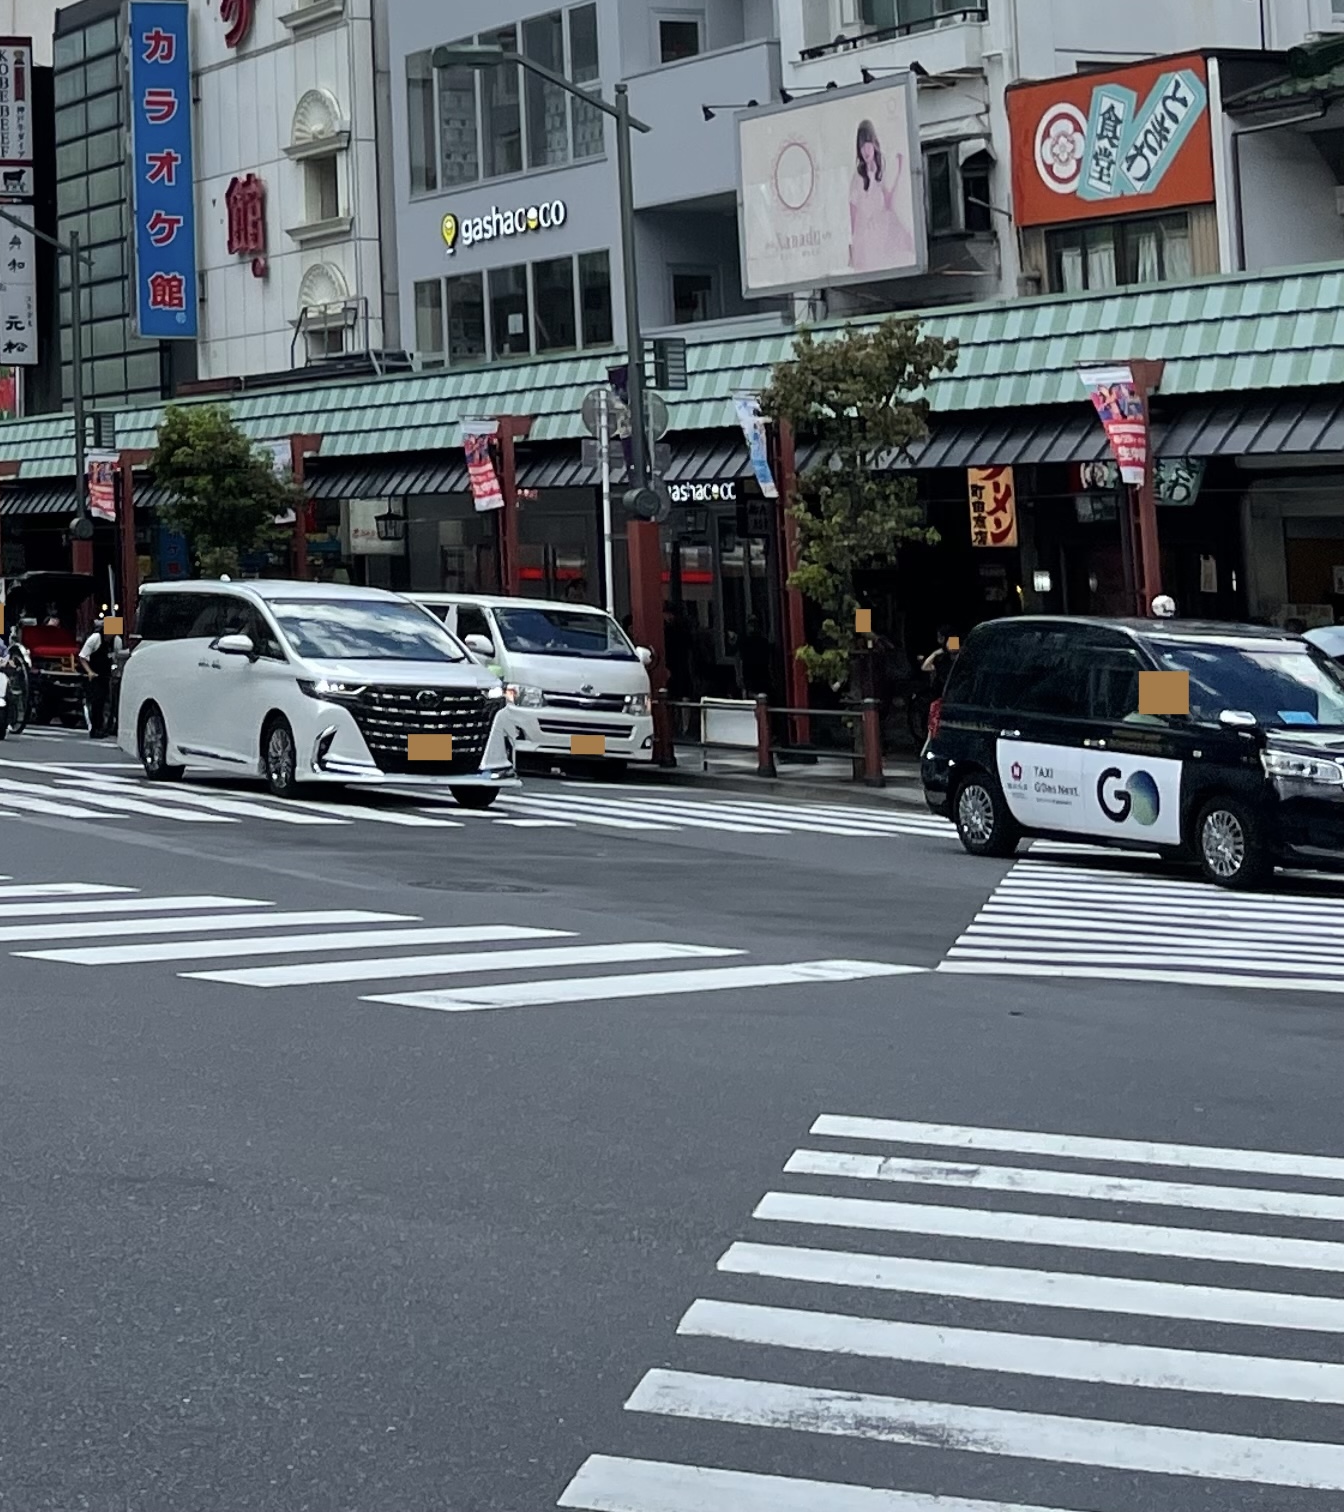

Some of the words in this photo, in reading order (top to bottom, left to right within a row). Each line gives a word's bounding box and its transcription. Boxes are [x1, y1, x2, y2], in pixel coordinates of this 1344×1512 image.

[139, 28, 189, 311] カラオケ館
[1033, 765, 1054, 779] TAXI
[1097, 766, 1160, 826] GO
